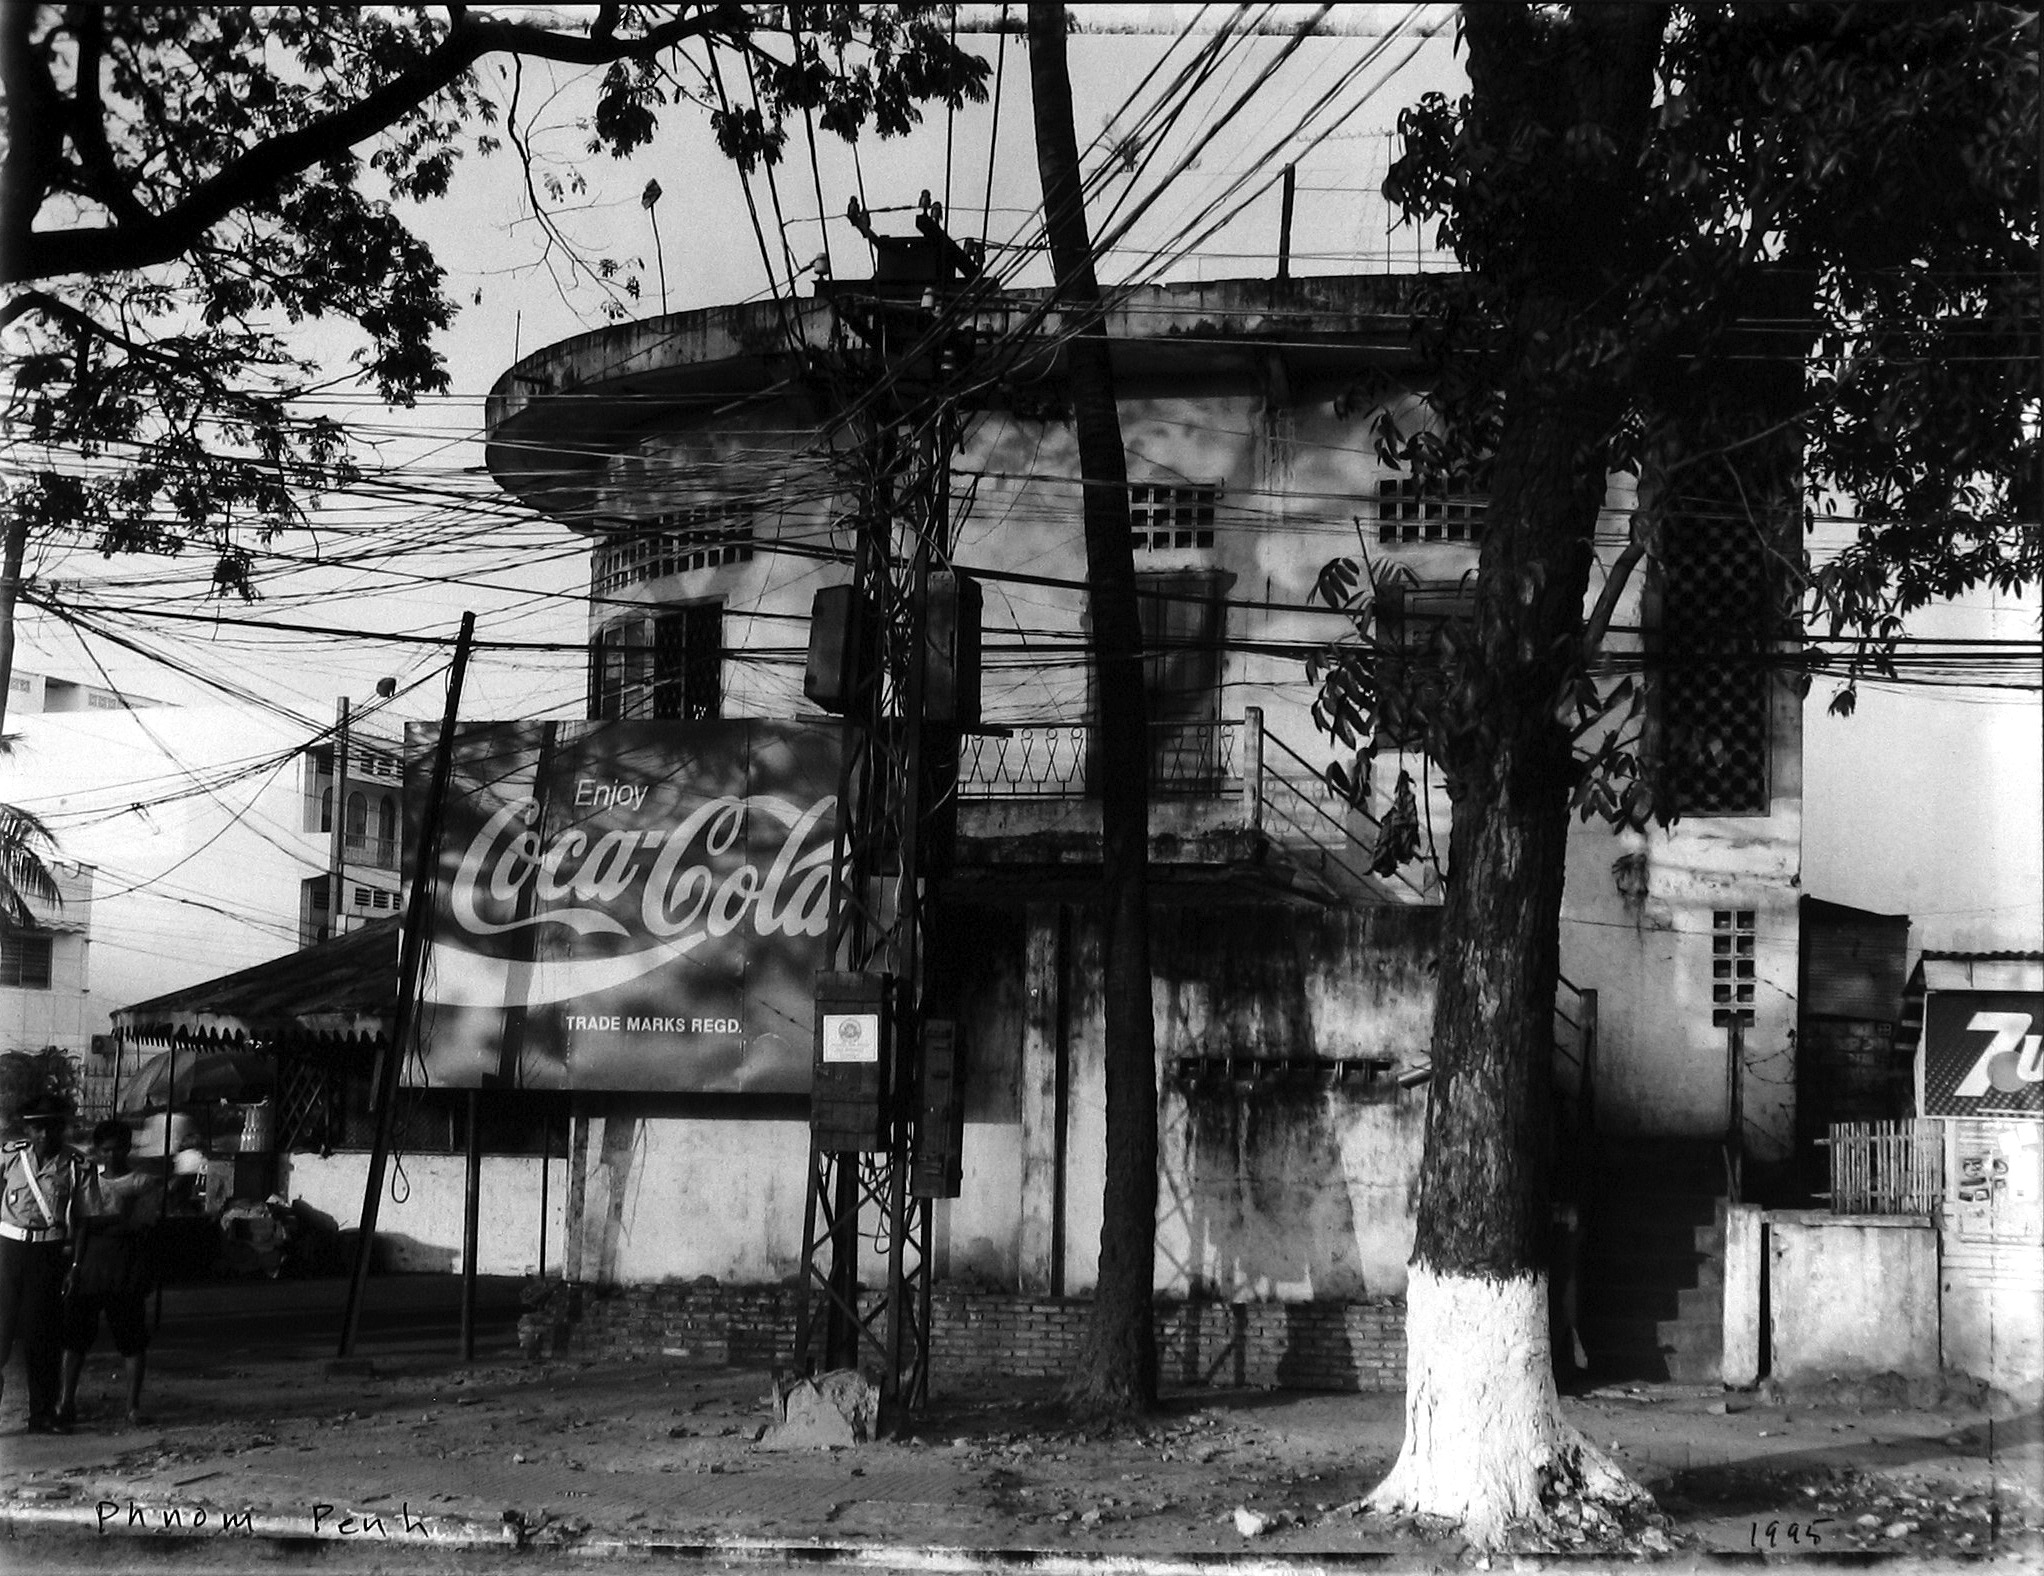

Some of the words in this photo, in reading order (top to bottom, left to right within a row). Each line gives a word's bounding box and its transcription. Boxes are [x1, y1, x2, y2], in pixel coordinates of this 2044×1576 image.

[575, 778, 650, 812] Enjoy
[452, 795, 851, 937] Coca-Cola
[566, 1015, 620, 1031] TRADE
[627, 1016, 685, 1033] MARKS
[692, 1017, 742, 1034] REGD.
